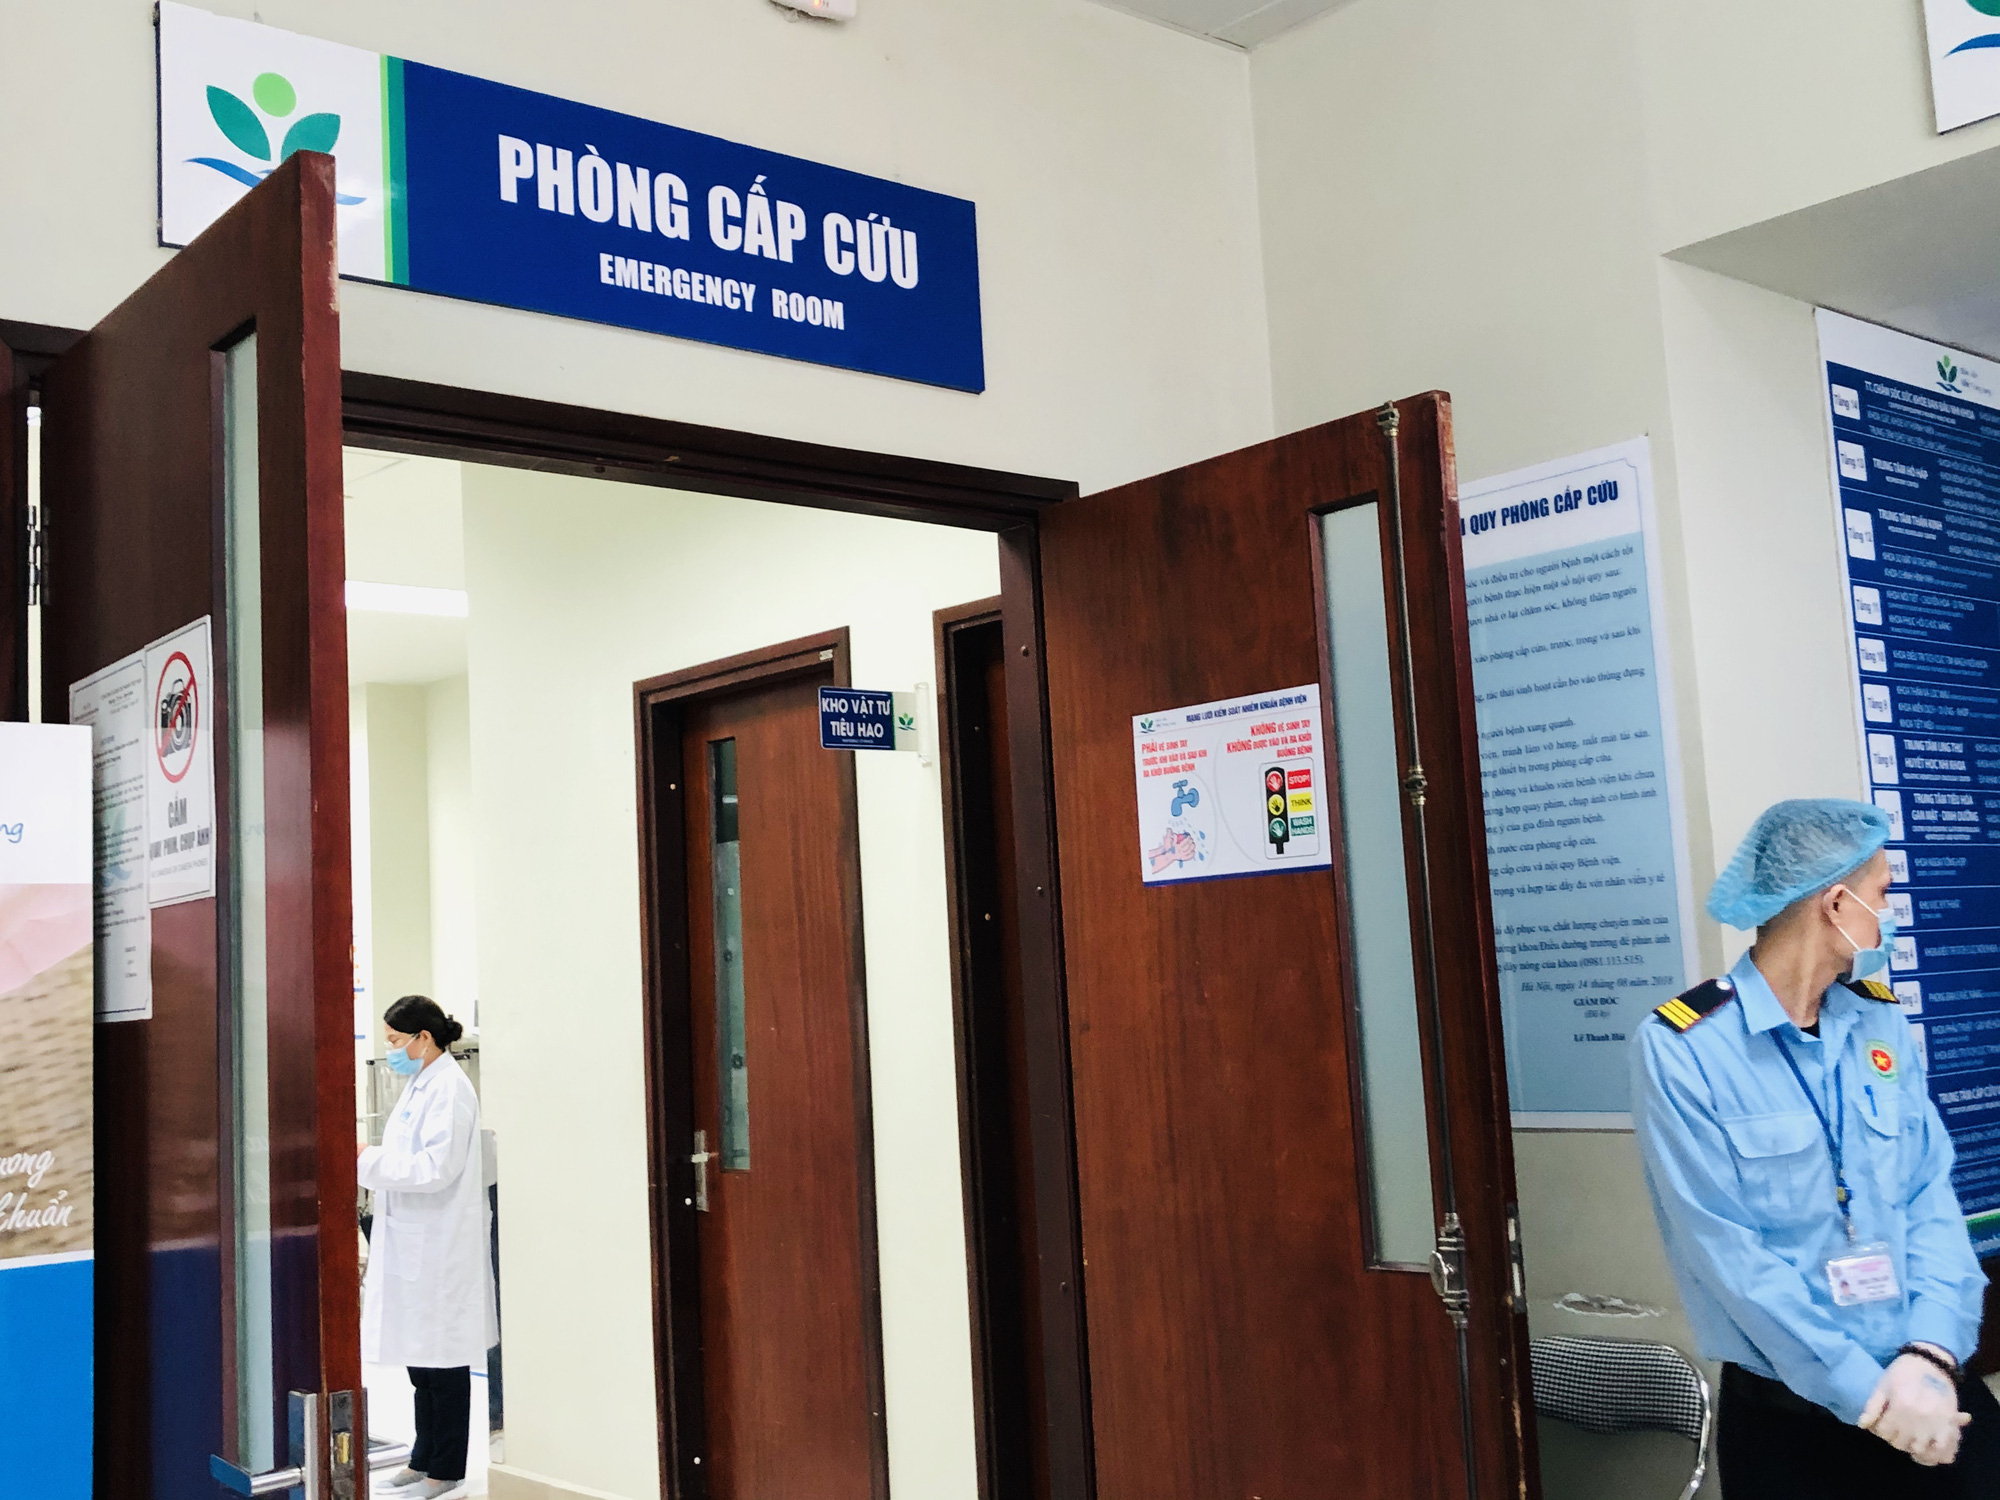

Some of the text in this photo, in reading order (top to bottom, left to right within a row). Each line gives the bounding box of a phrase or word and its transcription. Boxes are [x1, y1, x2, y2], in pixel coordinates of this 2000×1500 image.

[499, 134, 919, 289] PHÒNG CẤP CỨU
[600, 253, 845, 330] EMERGENCY ROOM
[1470, 509, 1497, 535] QUY
[1501, 497, 1550, 527] PHÒNG
[1553, 485, 1583, 514] CẤP
[1587, 479, 1619, 506] CỨU
[821, 695, 891, 719] KHO VẬT TƯ
[829, 717, 884, 739] TIÊU HAO
[1250, 721, 1276, 737] KHÔNG
[1286, 720, 1300, 731] SINH
[1141, 738, 1158, 754] PHẢI
[1226, 738, 1252, 754] KHÔNG
[1288, 774, 1311, 785] STOP!
[168, 792, 188, 829] CẤM
[1291, 798, 1312, 807] THINK
[1291, 825, 1315, 835] HANDS
[1292, 817, 1312, 826] WASH
